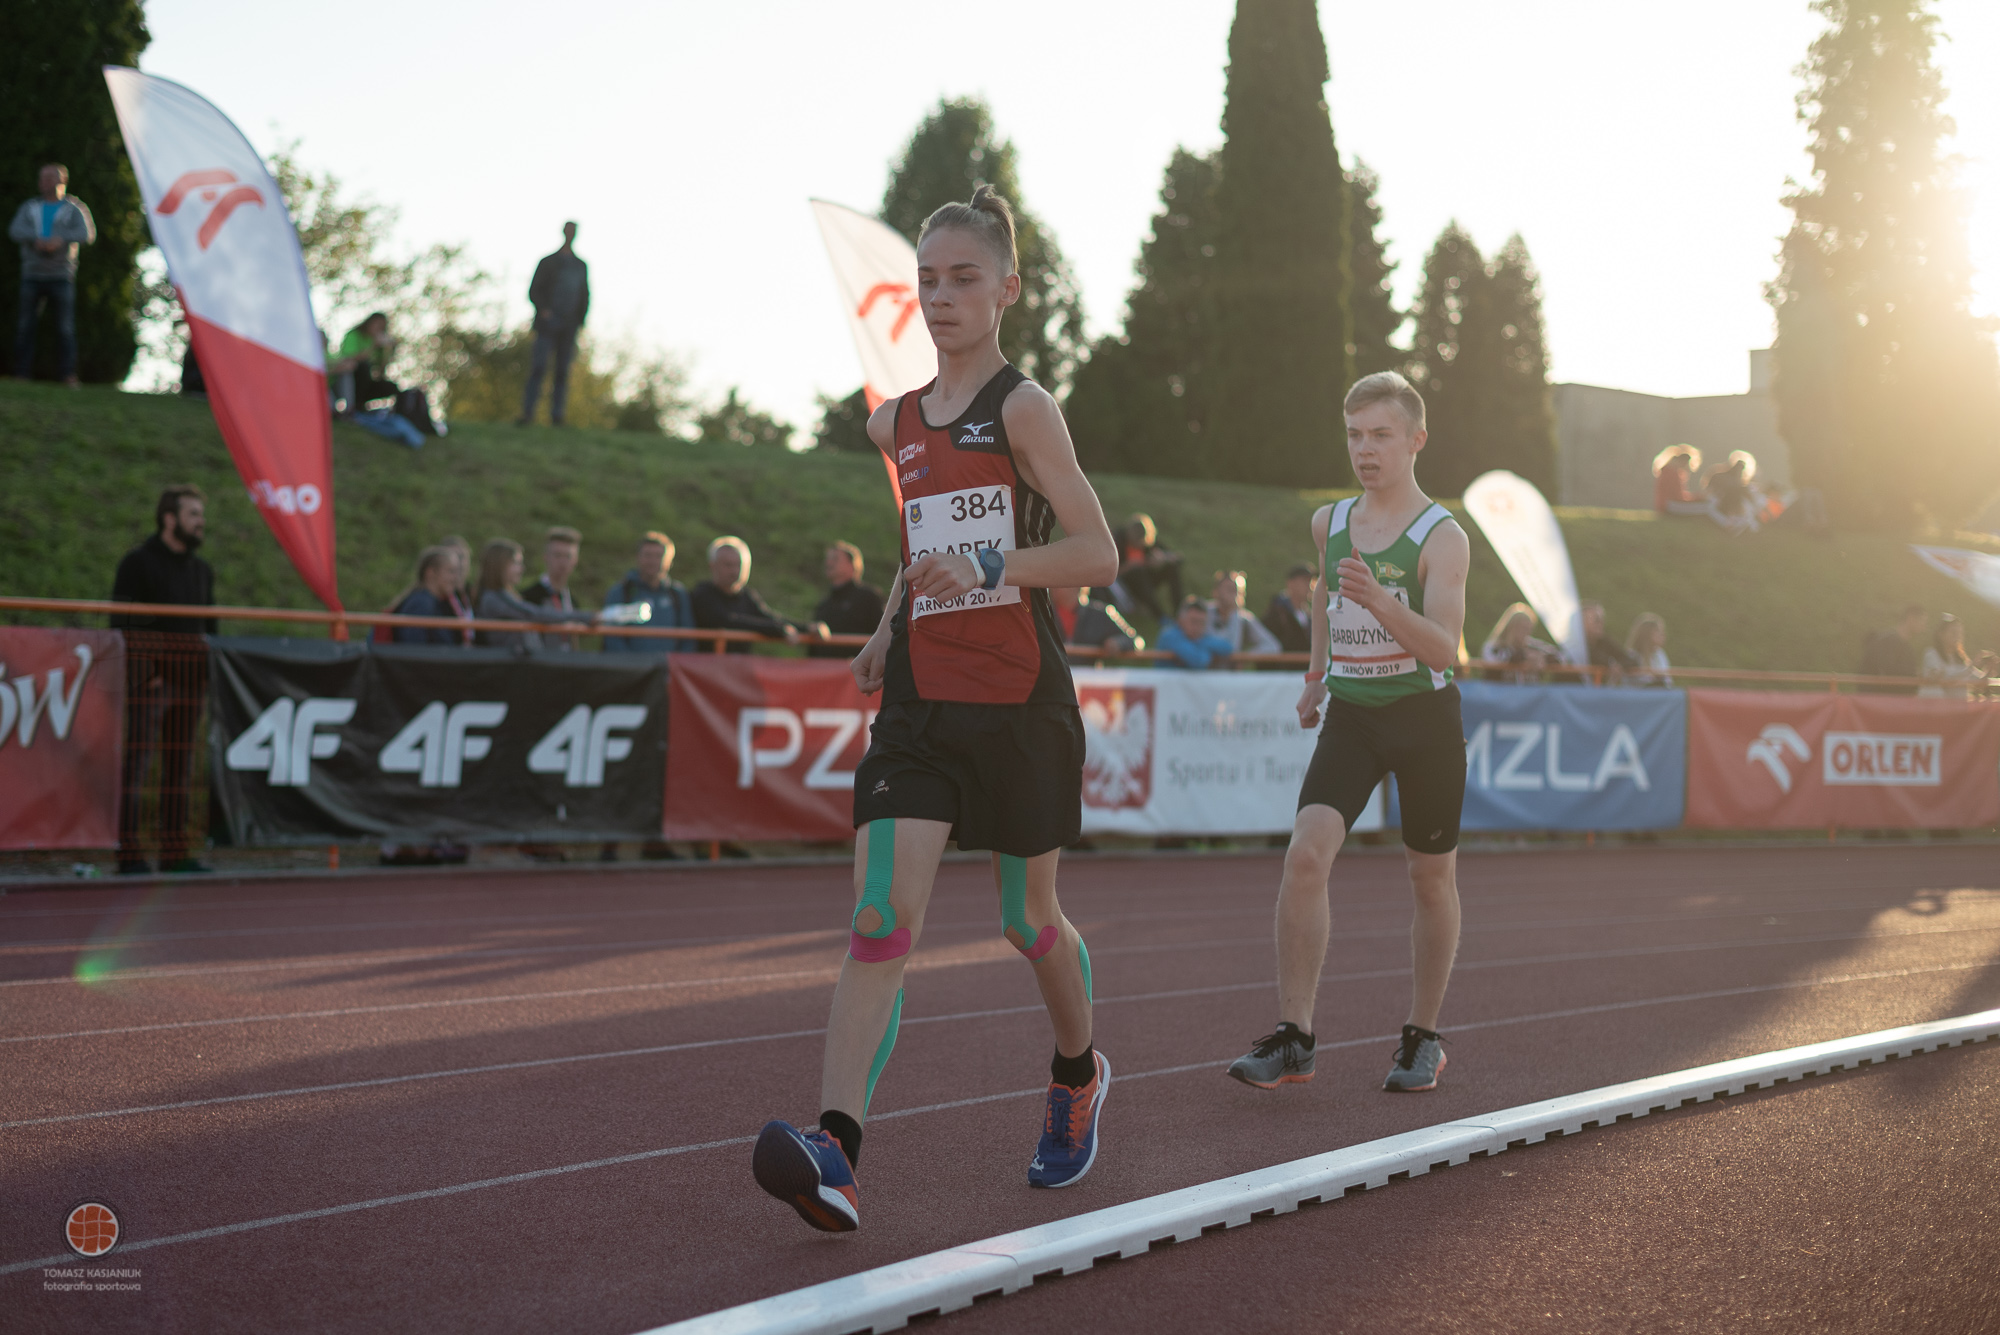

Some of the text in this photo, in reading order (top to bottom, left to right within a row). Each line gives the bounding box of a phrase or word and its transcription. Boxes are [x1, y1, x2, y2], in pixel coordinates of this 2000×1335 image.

[959, 435, 994, 443] MIZUNO
[951, 490, 1006, 521] 384
[970, 592, 1002, 606] 20
[1342, 663, 1400, 676] TARNÓW 2019
[226, 697, 648, 787] 4F 4F 4F
[737, 706, 880, 790] PZ
[1831, 743, 1934, 776] ORLEN
